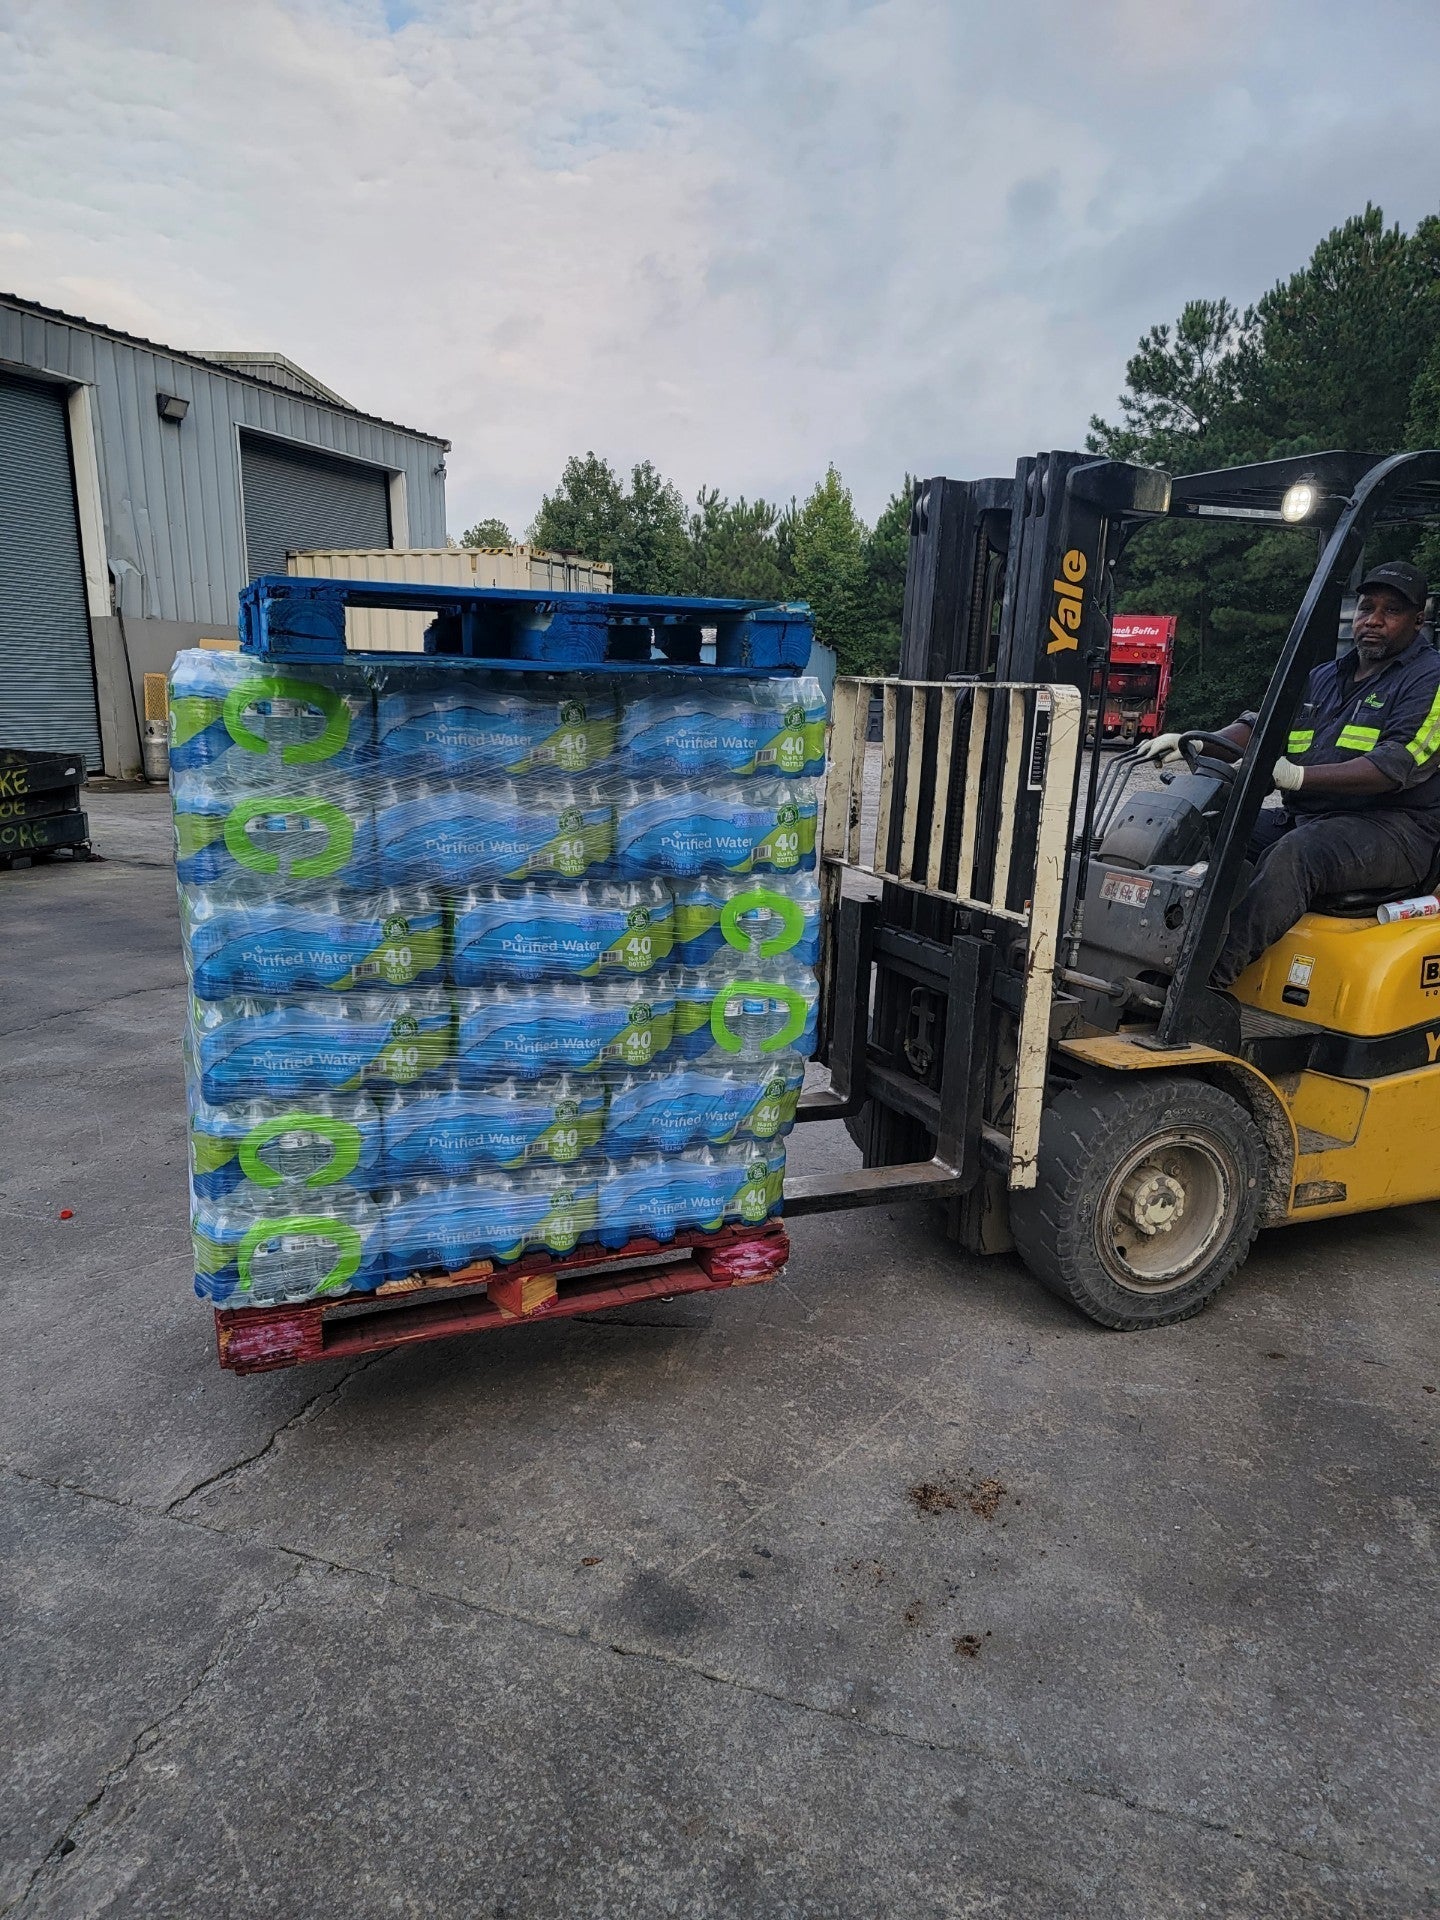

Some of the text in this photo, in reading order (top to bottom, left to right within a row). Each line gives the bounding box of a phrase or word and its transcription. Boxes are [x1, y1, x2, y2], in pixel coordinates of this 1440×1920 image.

[1046, 549, 1087, 655] Yale
[1132, 626, 1159, 635] Buffet
[424, 730, 533, 746] Purified Water
[559, 733, 587, 754] 40
[665, 736, 759, 749] Purified Water
[781, 737, 804, 755] 40
[425, 839, 531, 854] Purified Water
[558, 840, 584, 859] 40
[661, 836, 753, 850] Purified Water
[775, 832, 799, 851] 40
[502, 940, 602, 954] Purified Water
[626, 936, 652, 956] 40
[242, 951, 354, 967] Purified Water
[383, 946, 412, 967] 40
[1427, 963, 1440, 980] B
[504, 1037, 603, 1054] Purified Water
[627, 1030, 652, 1050] 40
[252, 1053, 362, 1071] Purified Water
[390, 1046, 419, 1067] 40
[651, 1110, 740, 1129] Purified Water
[757, 1104, 780, 1122] 40
[429, 1133, 528, 1149] Purified Water
[552, 1128, 578, 1148] 40
[639, 1196, 725, 1215] Purified Water
[745, 1187, 766, 1206] 40
[427, 1225, 523, 1244] Purified Water
[549, 1217, 574, 1235] 40
